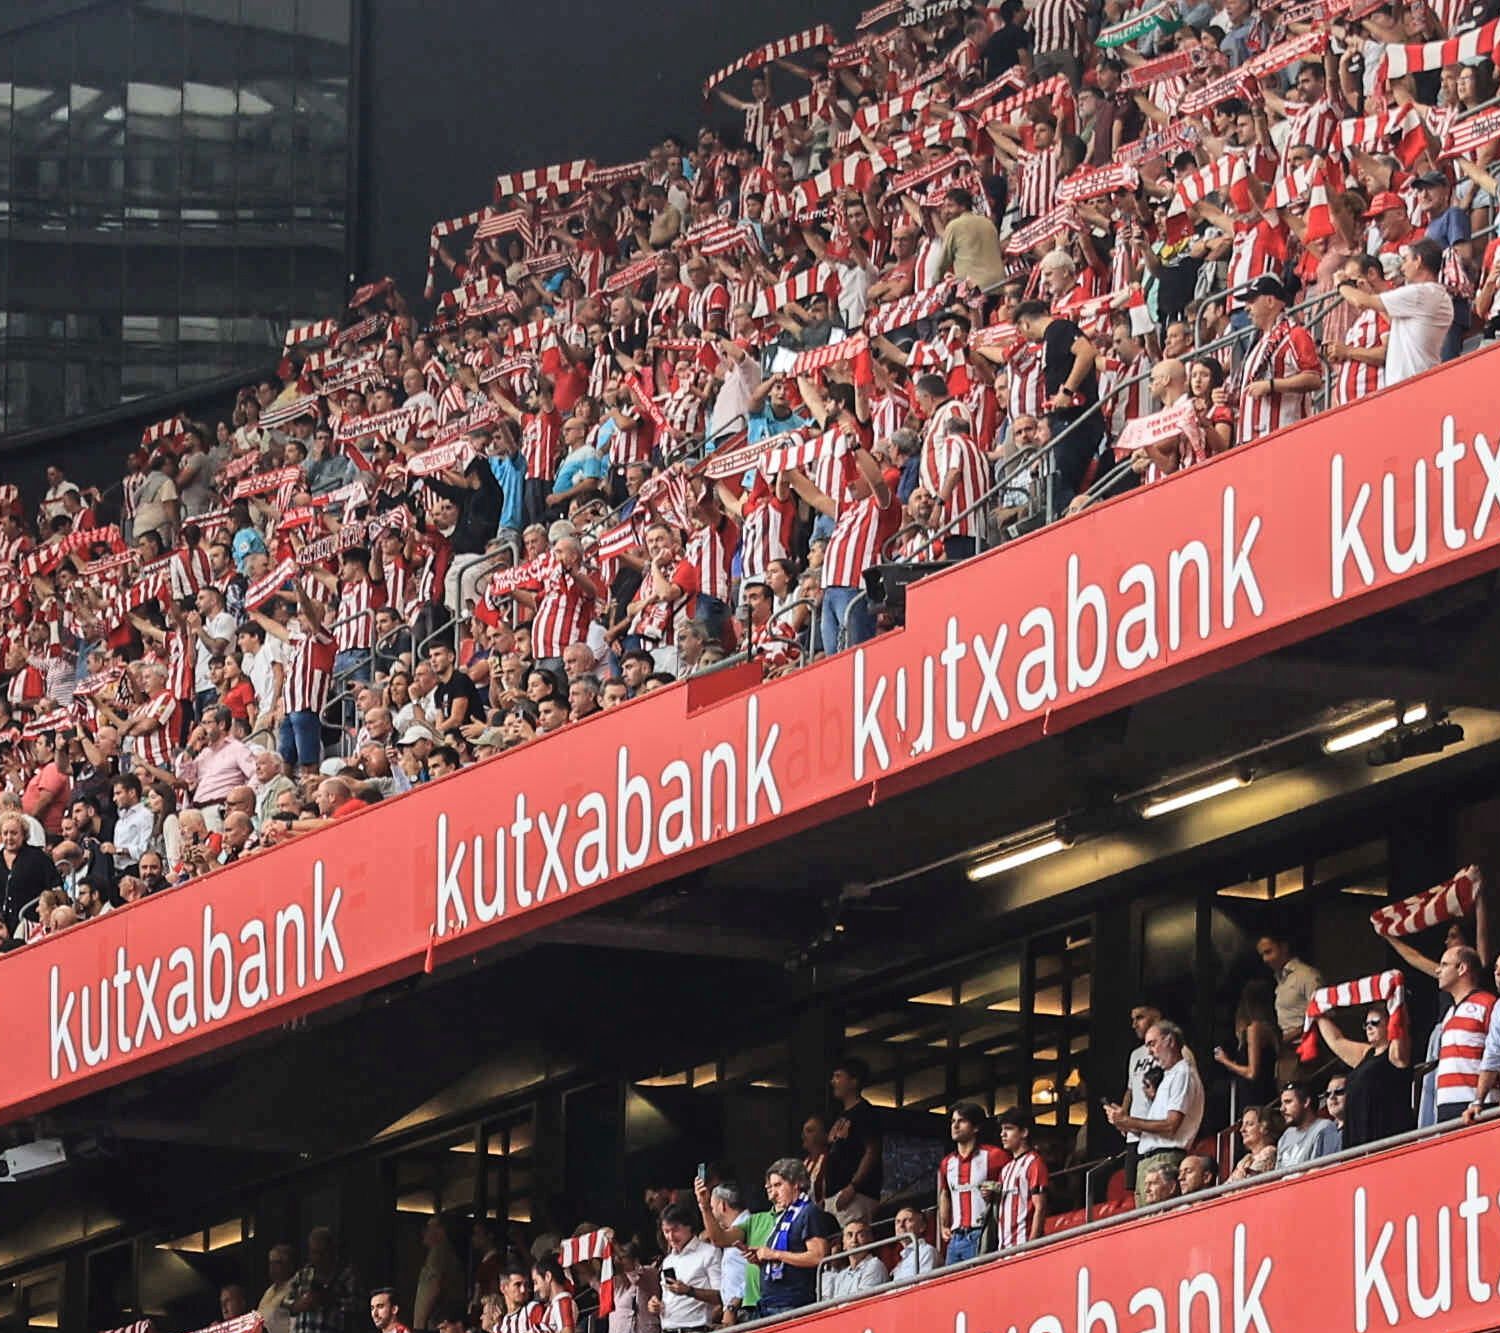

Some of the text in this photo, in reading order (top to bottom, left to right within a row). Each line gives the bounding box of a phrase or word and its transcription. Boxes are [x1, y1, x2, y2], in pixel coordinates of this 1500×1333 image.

[847, 479, 1264, 781] kutxabank
[434, 690, 782, 937] kutxabank
[50, 854, 344, 1079] kutxabank
